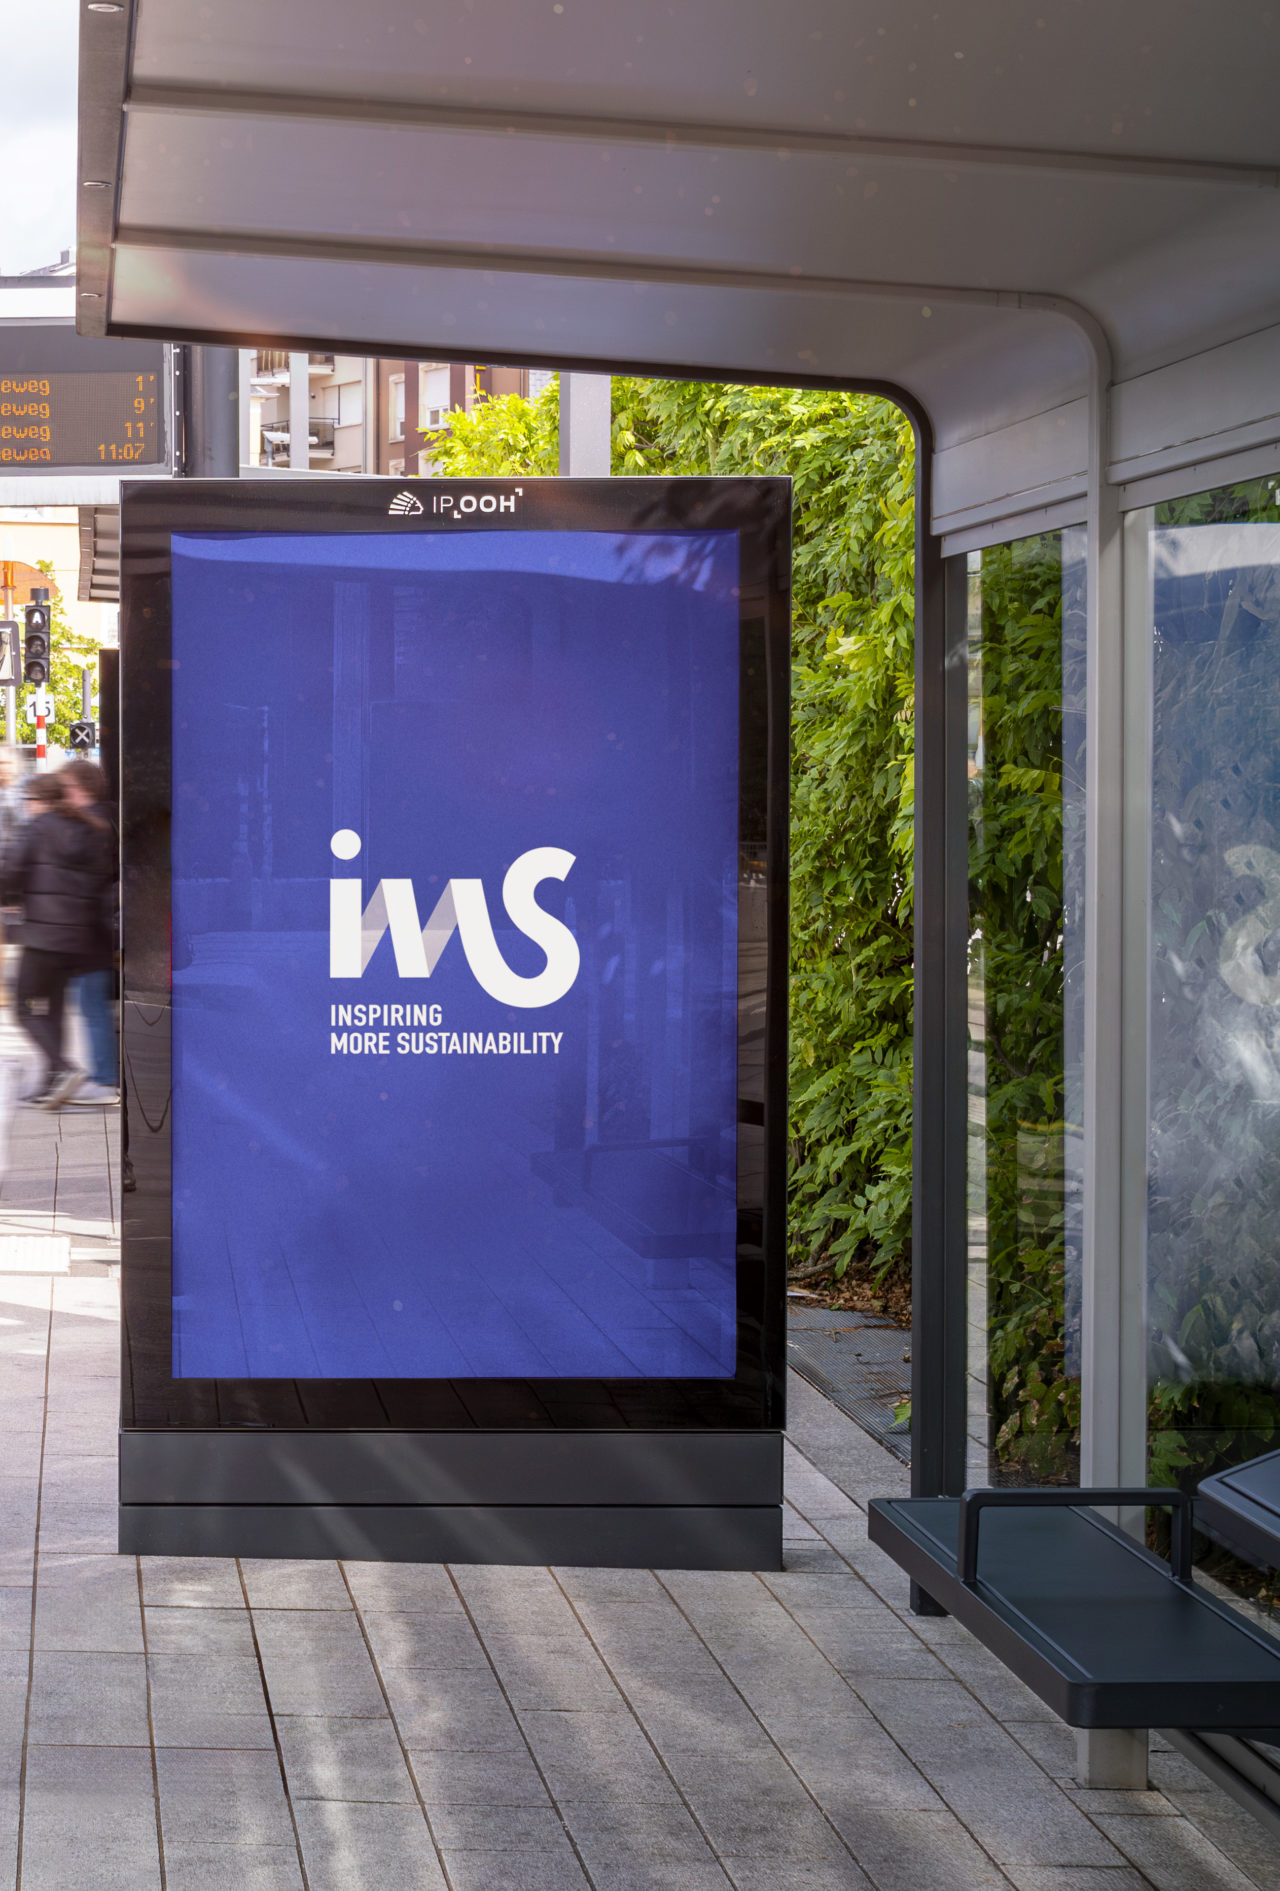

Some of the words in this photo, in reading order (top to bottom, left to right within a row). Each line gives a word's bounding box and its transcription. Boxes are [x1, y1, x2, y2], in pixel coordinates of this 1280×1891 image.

[97, 444, 145, 460] 11:07
[330, 1004, 443, 1027] INSPIRING
[330, 1032, 390, 1054] MORE
[396, 1032, 564, 1054] SUSTAINABILITY
